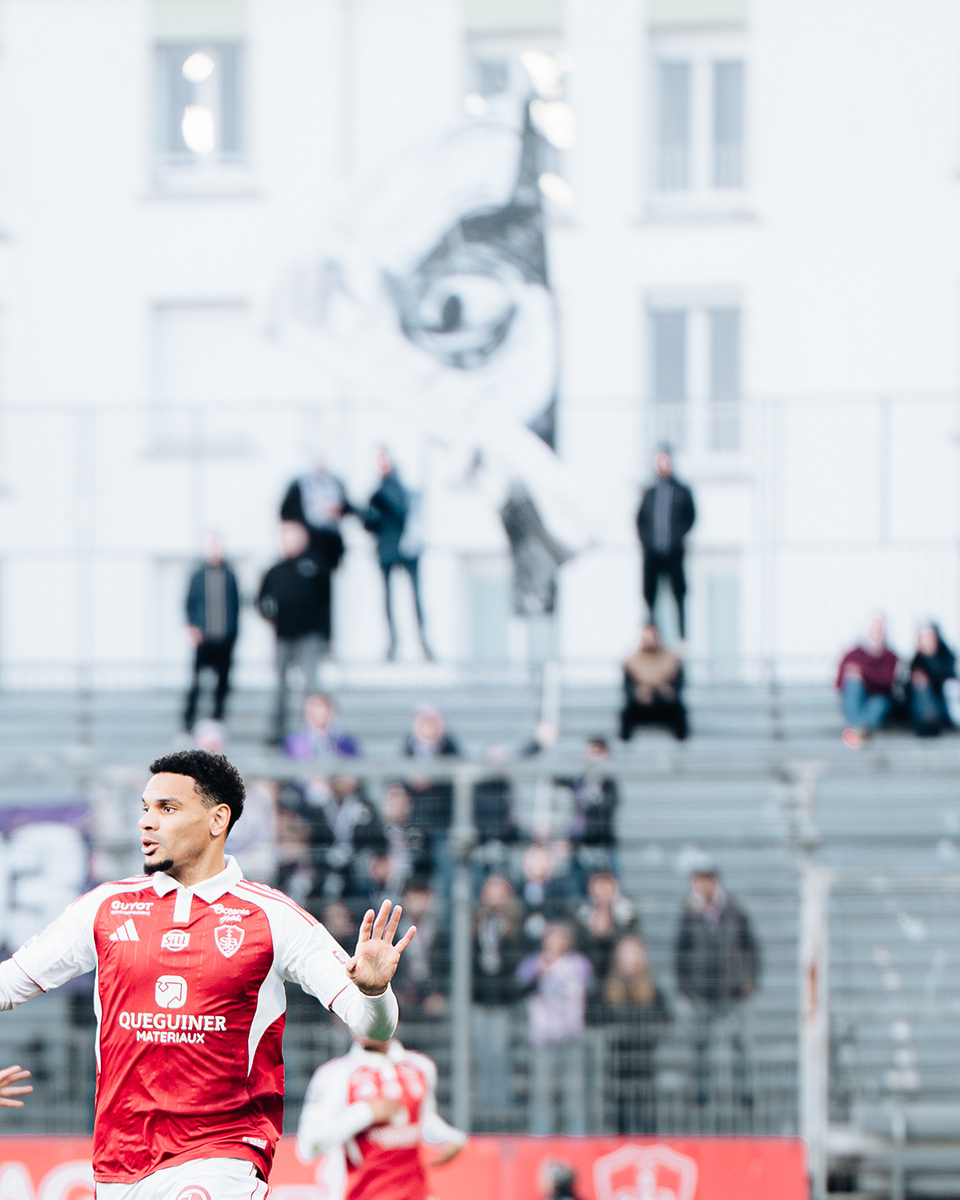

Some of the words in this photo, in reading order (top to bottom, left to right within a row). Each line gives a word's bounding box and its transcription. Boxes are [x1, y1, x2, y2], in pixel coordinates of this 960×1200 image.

[111, 900, 154, 911] GUYOT
[119, 1011, 227, 1031] QUEGUINER
[136, 1030, 205, 1043] MATERIAUX
